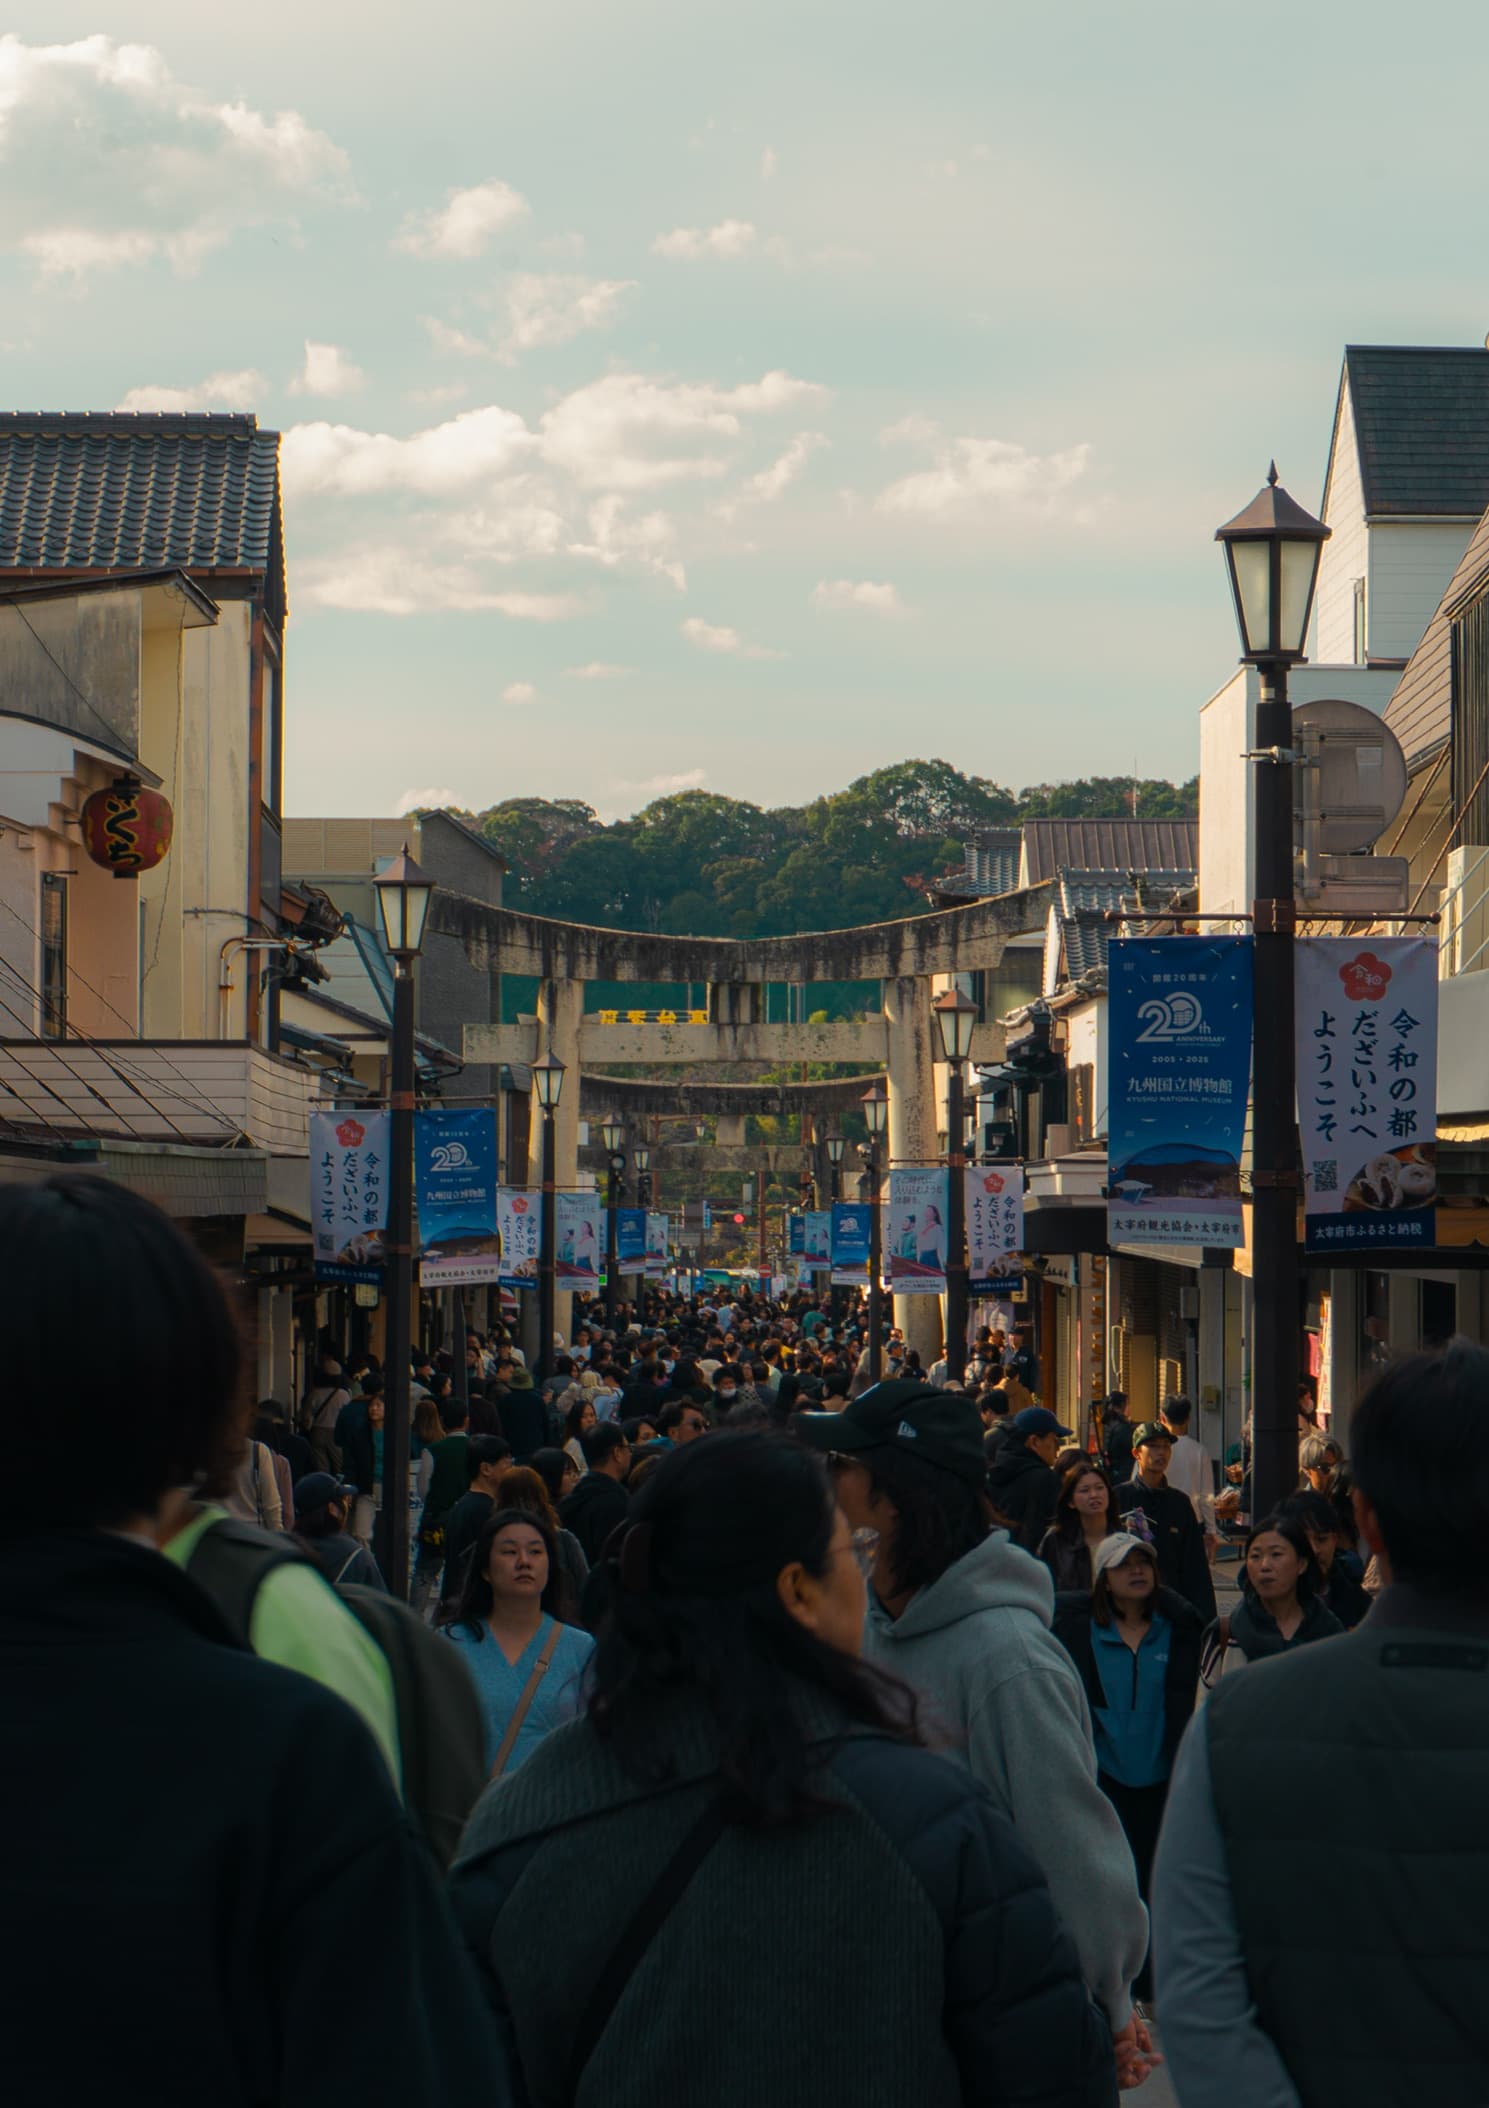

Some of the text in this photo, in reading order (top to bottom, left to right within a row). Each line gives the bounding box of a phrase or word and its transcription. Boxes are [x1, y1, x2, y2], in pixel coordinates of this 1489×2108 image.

[1176, 1035, 1227, 1043] ANNIVERSARY
[1125, 1096, 1233, 1105] KYUSHU NATIONAL MUSEUM
[1127, 1076, 1233, 1094] 九州国立博物館
[1313, 1009, 1338, 1143] ようこそ
[1349, 1009, 1380, 1140] だざいふへ
[1386, 1008, 1422, 1139] 令和の都
[320, 1151, 336, 1225] ようこそ
[341, 1151, 359, 1225] だざいふへ
[362, 1151, 381, 1225] 令和の都
[973, 1196, 984, 1250] ようこそ
[987, 1196, 1001, 1249] だざいふへ
[1003, 1195, 1016, 1248] 令和の都
[1314, 1221, 1423, 1240] 太宰府市ふるさと納税
